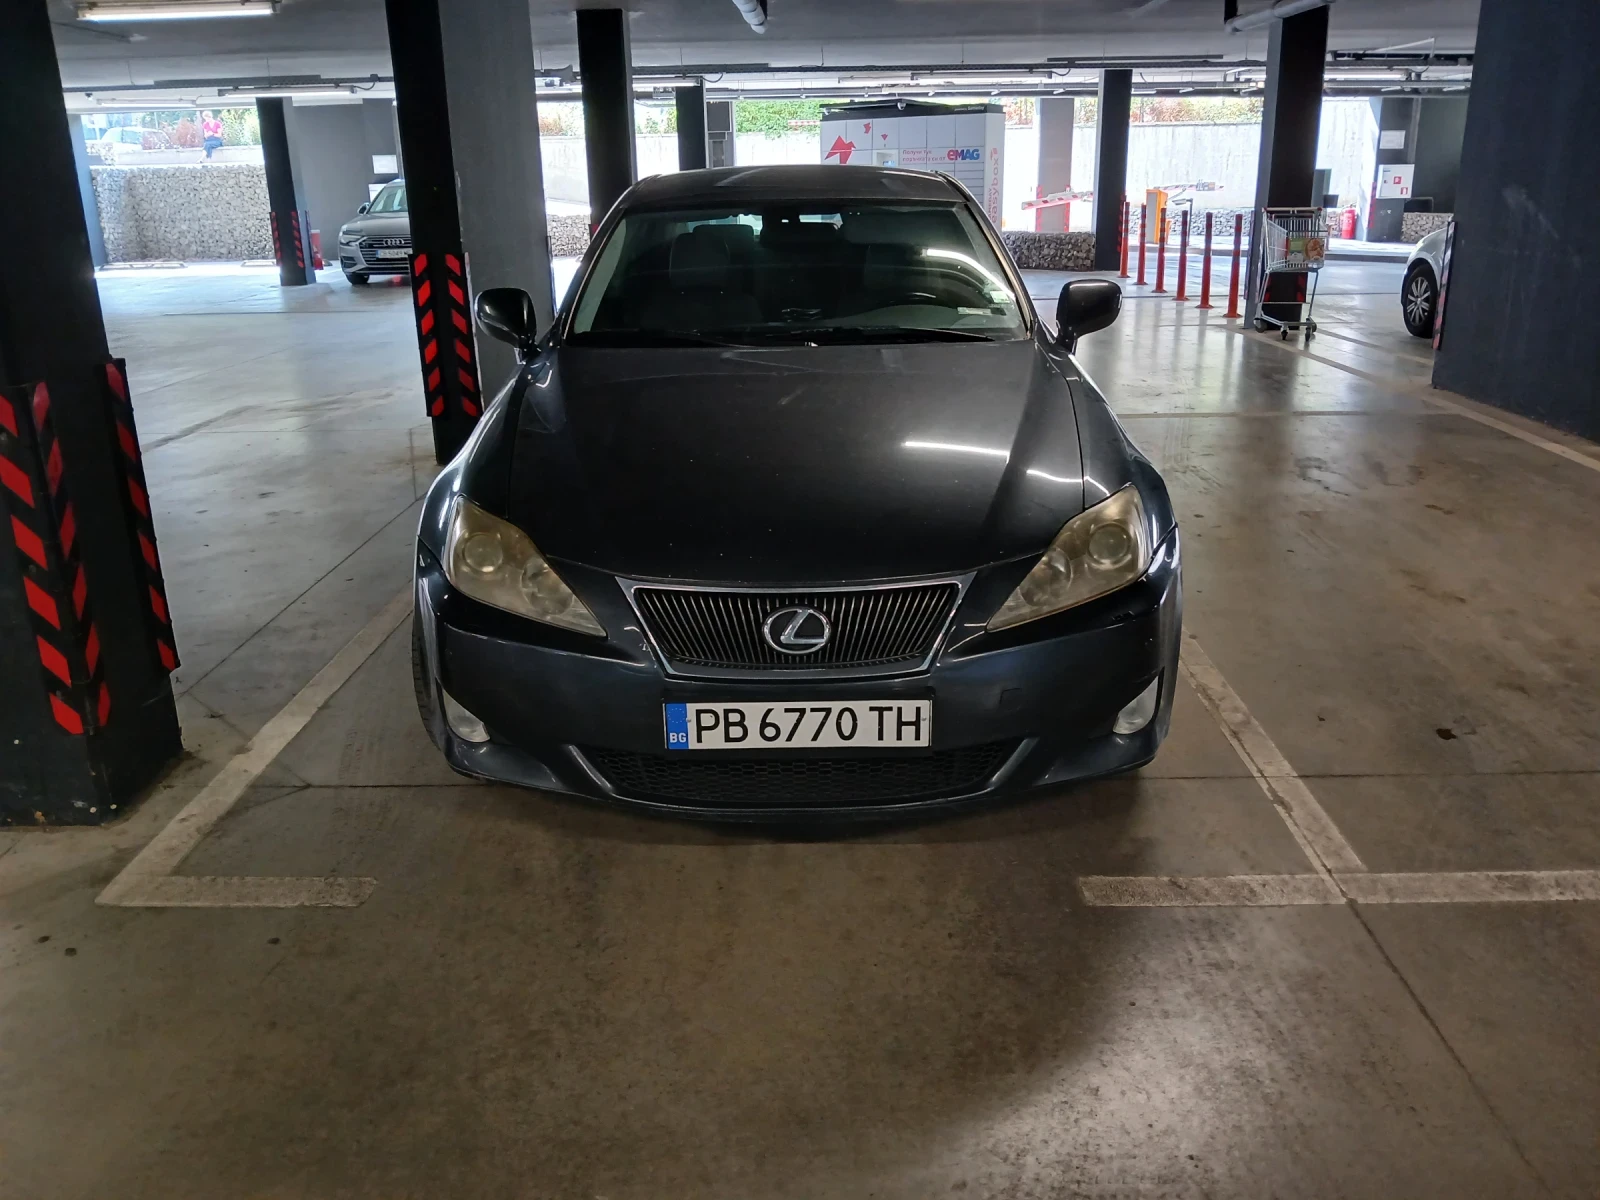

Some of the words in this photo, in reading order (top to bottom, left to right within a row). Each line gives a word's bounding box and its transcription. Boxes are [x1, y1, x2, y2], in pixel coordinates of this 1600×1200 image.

[947, 149, 980, 161] eMAG
[991, 158, 999, 224] easybox
[695, 708, 749, 744] PB
[758, 707, 859, 742] 6770
[868, 706, 921, 741] TH
[669, 733, 687, 743] BG
